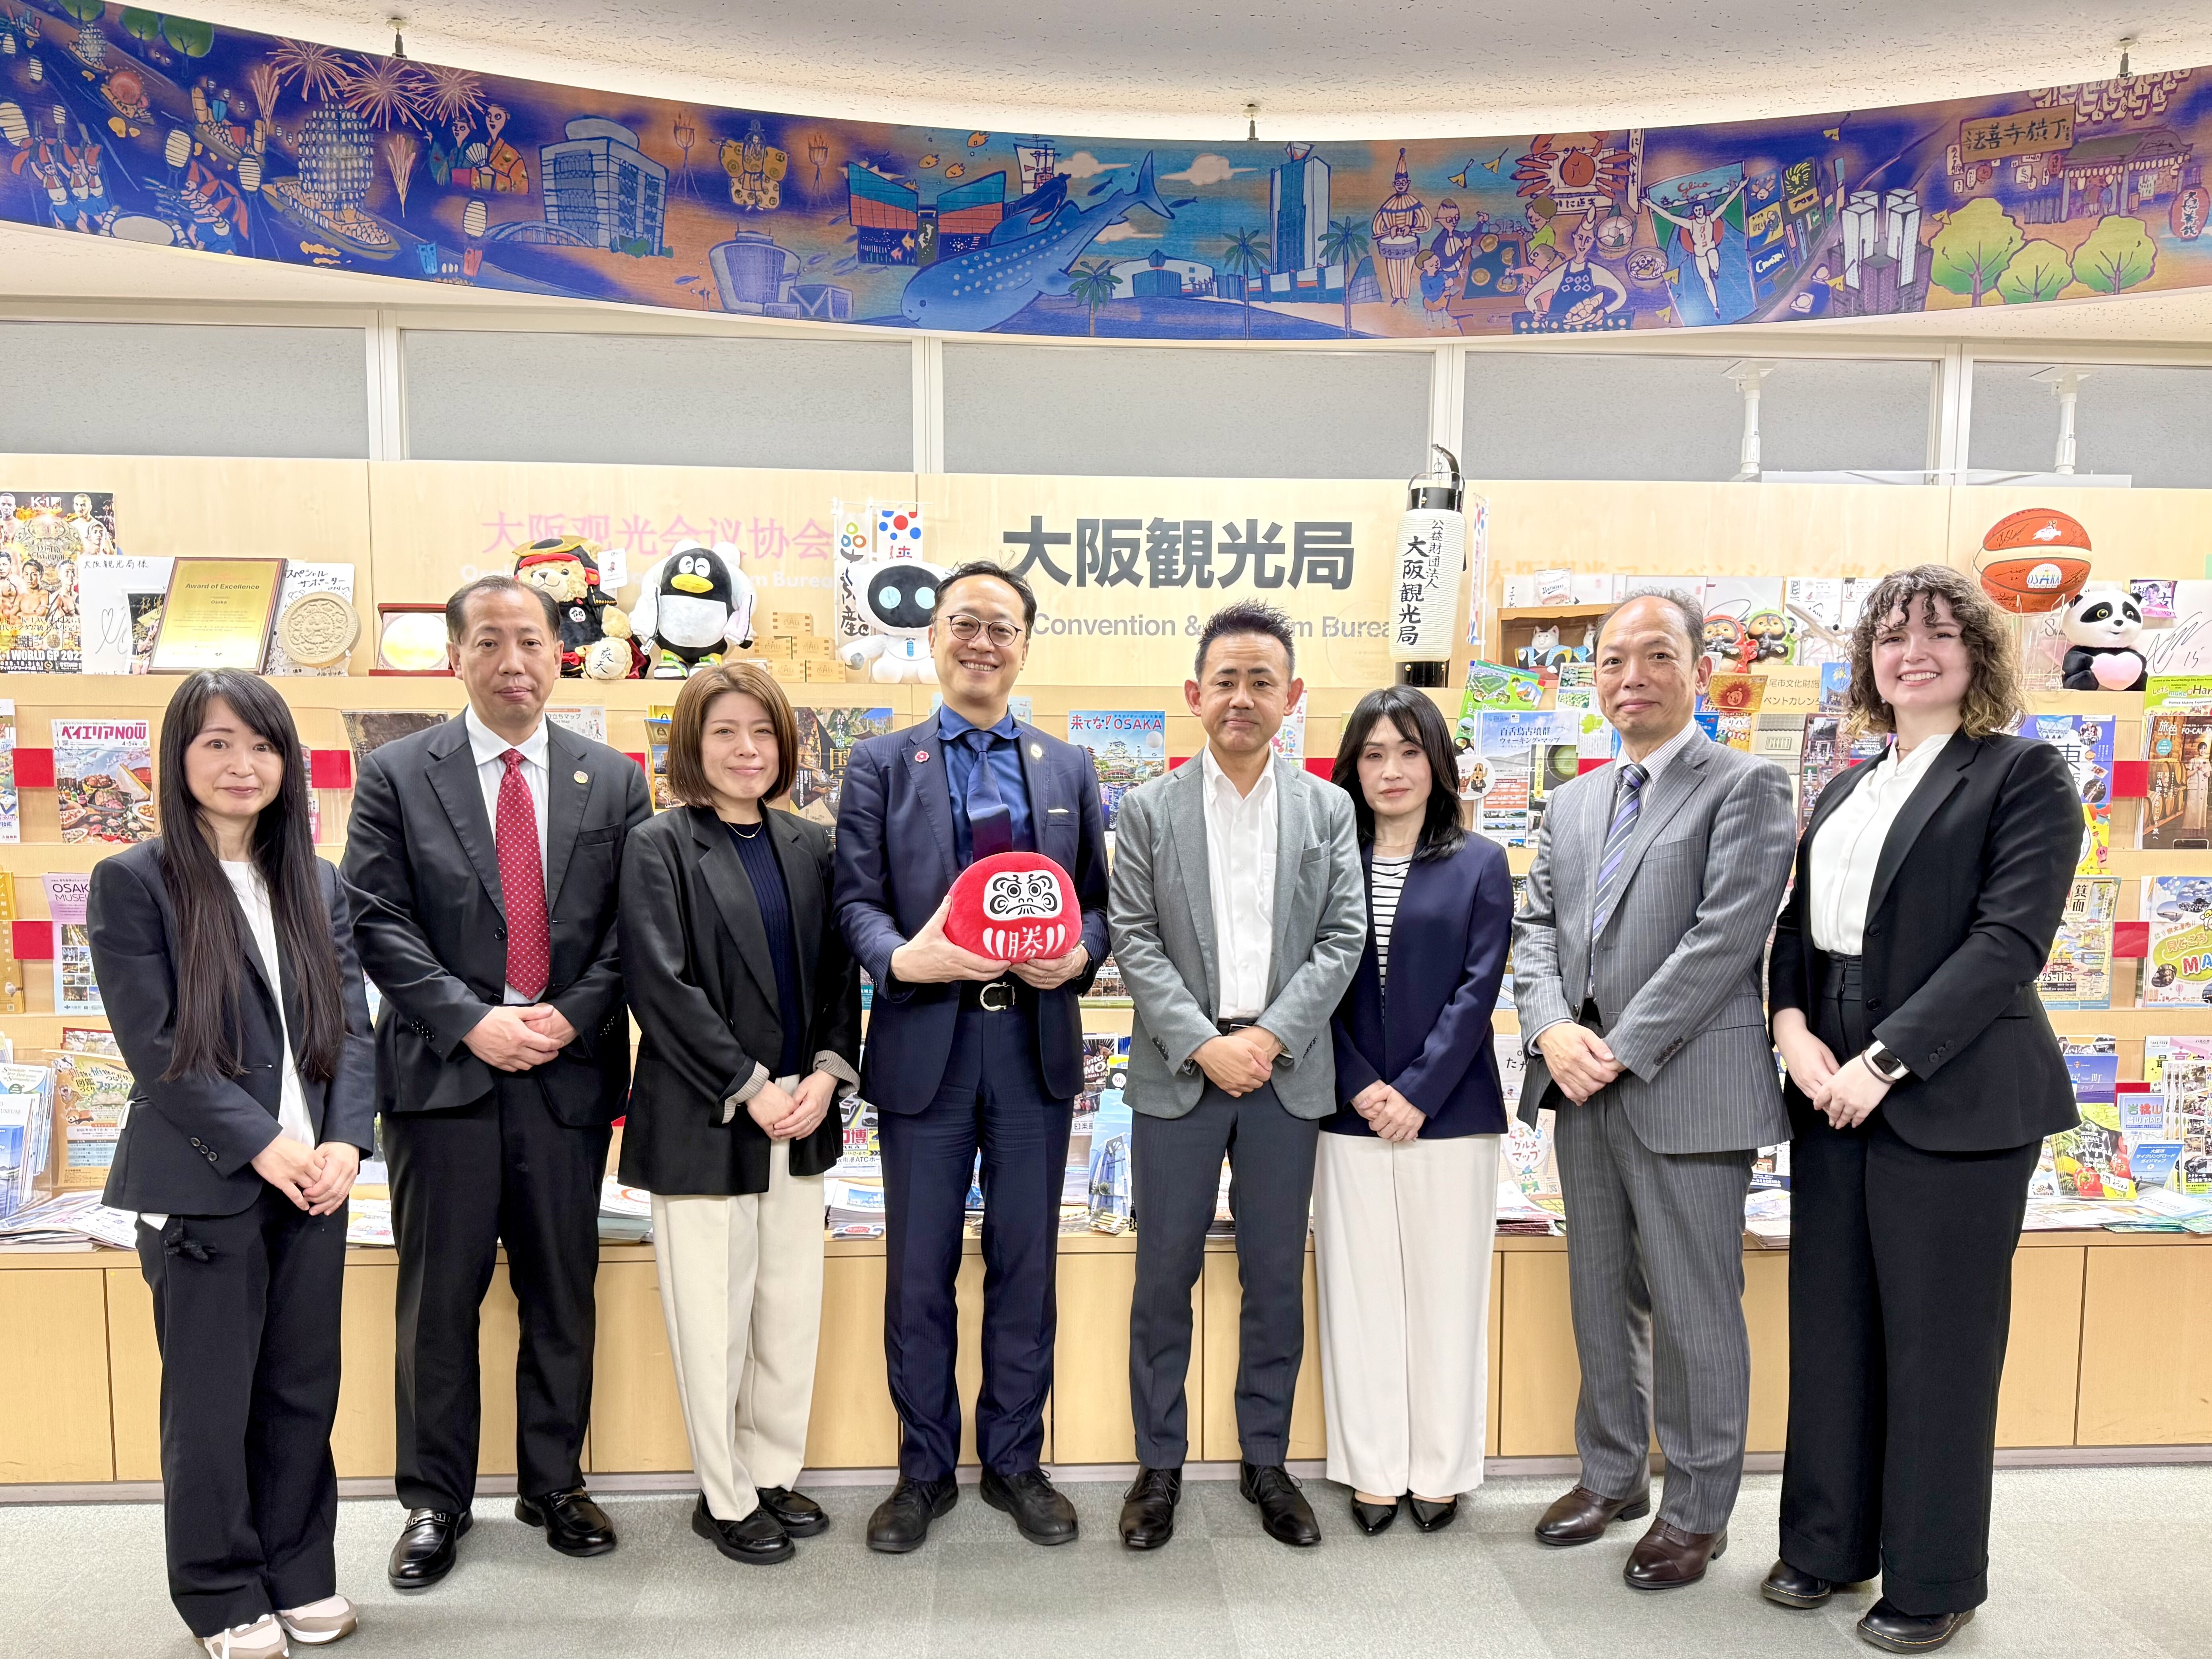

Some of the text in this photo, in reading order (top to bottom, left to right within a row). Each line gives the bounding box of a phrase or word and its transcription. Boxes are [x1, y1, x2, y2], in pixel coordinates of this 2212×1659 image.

[1963, 118, 2067, 150] 法善寺横丁
[1677, 181, 1711, 197] Glico
[1699, 224, 1708, 248] グリコ
[31, 497, 49, 507] K-1
[1003, 515, 1354, 590] 大阪観光局
[1424, 519, 1444, 589] 公益財団法人
[84, 559, 149, 569] 大阪観光局様
[286, 569, 329, 578] スペシャル
[1396, 535, 1430, 646] 大阪観光局
[1033, 613, 1176, 637] Convention
[11, 650, 45, 661] WORLD
[47, 650, 60, 661] GP
[1071, 714, 1163, 730] 来てな! OSAKA
[2158, 720, 2177, 736] 旅色
[61, 725, 146, 740] ベイエリアNOW
[836, 714, 845, 748] 春の大阪
[1500, 726, 1551, 736] 百舌鳥古墳群
[2072, 884, 2089, 912] 箕面
[1008, 925, 1043, 958] 勝
[2167, 932, 2208, 953] 見どころ
[1514, 1141, 1537, 1150] グルメ
[1512, 1150, 1541, 1162] マップ
